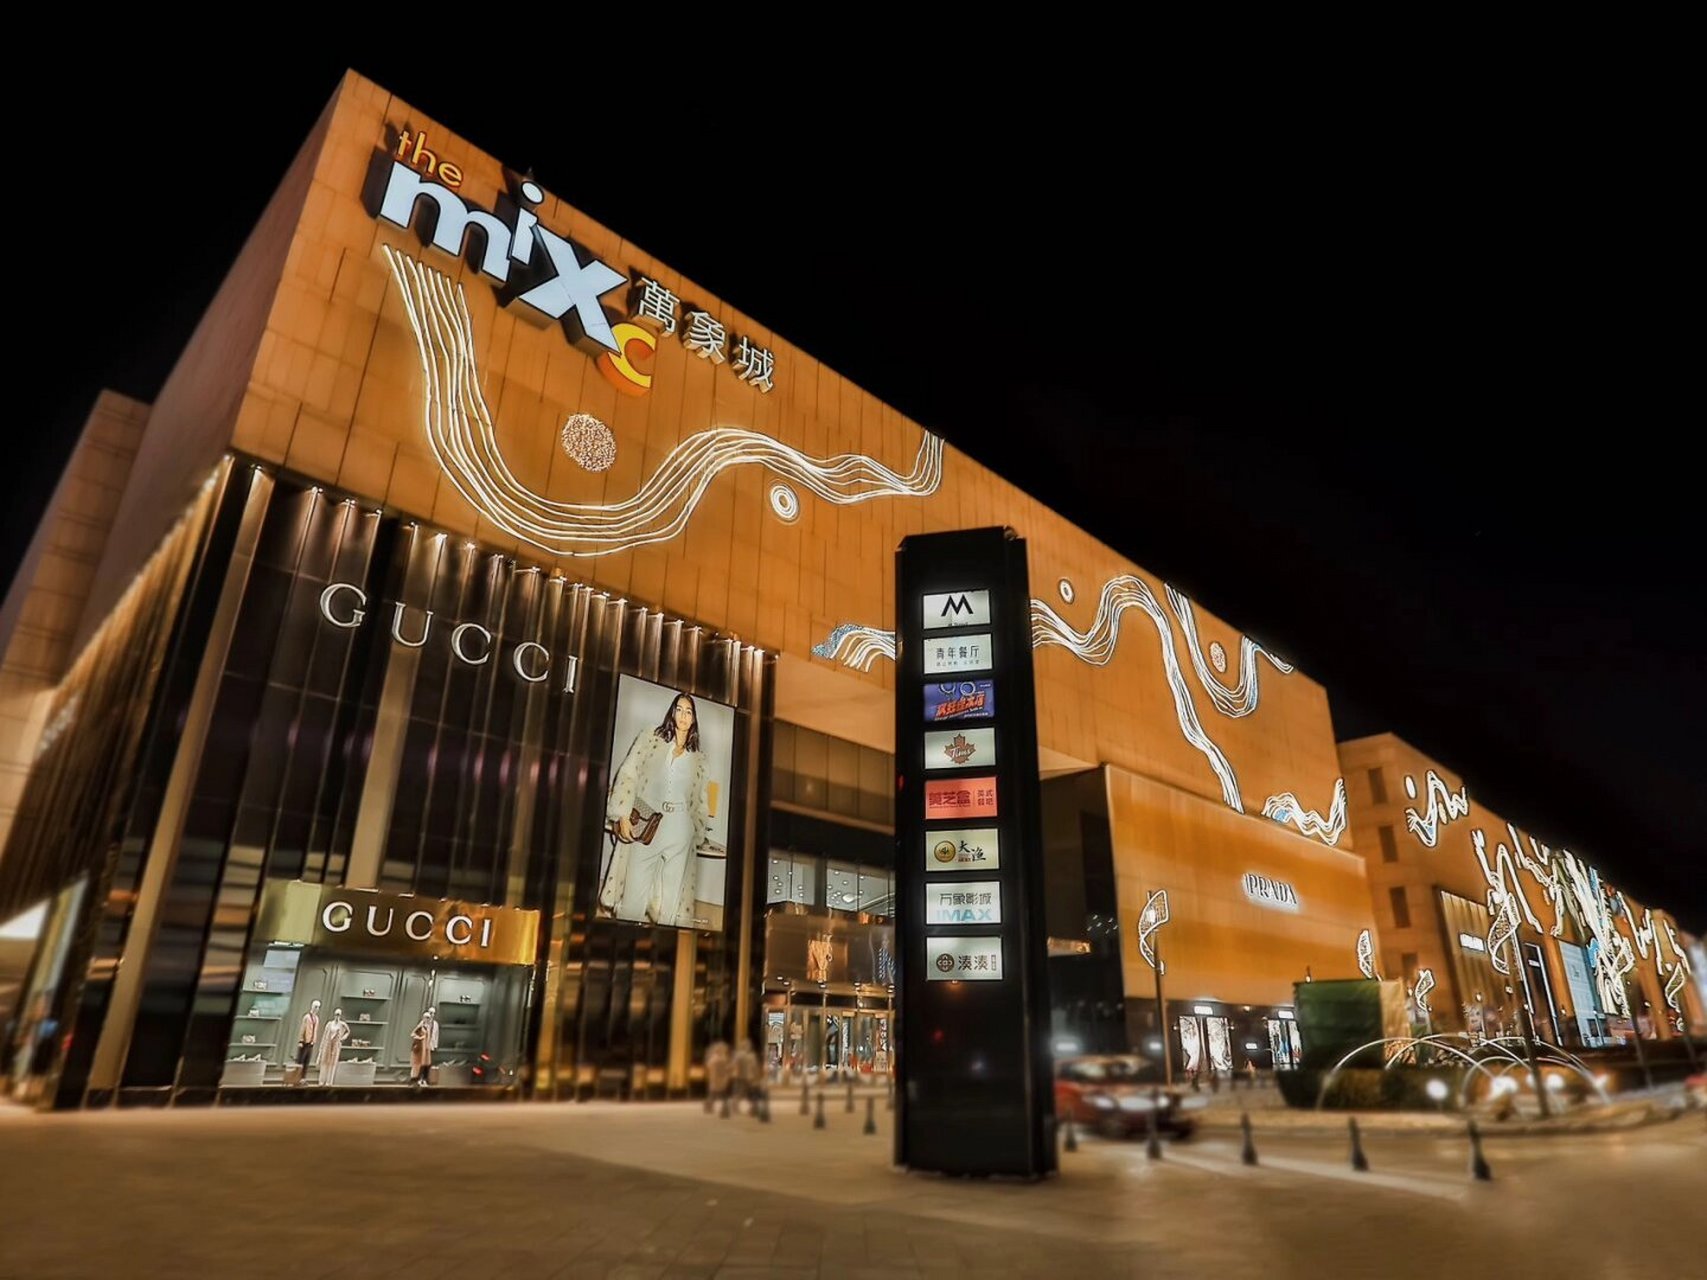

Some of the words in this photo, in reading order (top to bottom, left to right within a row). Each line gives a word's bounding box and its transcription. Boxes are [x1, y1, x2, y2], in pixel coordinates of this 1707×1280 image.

[398, 130, 464, 188] the
[635, 275, 777, 395] 萬象城
[318, 582, 580, 695] GUCCI
[936, 645, 980, 660] 青年餐厅
[939, 892, 992, 906] 万象影城
[1245, 873, 1298, 905] PRADA
[321, 900, 492, 948] GUCCI
[936, 908, 992, 922] IMAX
